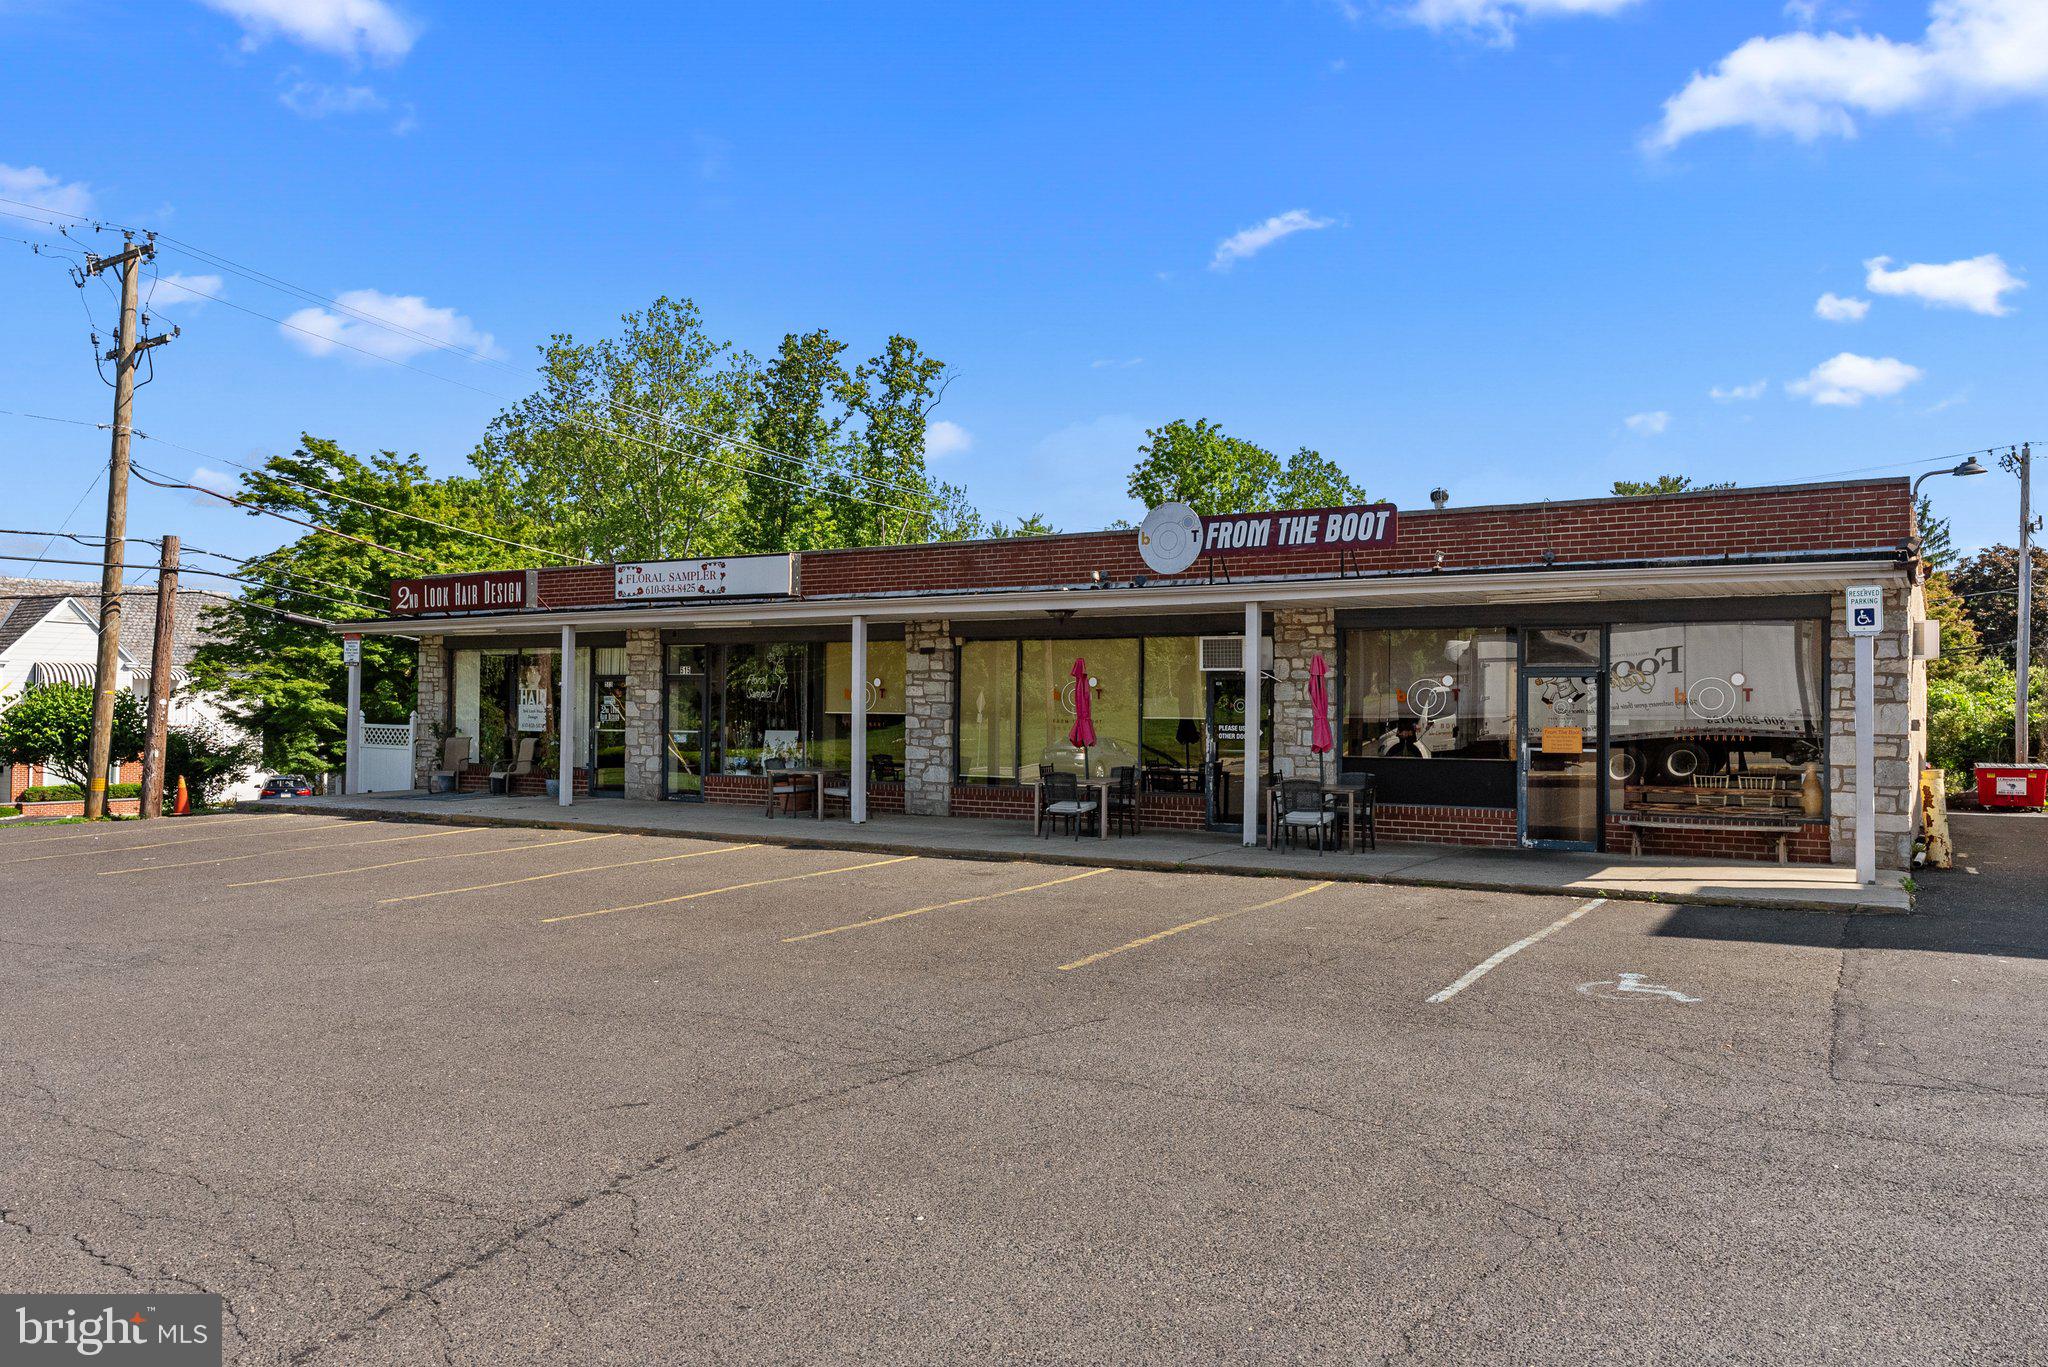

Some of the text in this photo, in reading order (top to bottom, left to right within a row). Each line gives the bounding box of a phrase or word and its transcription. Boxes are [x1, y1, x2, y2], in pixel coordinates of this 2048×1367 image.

[1205, 510, 1391, 549] FROM THE BOOT
[625, 570, 718, 584] FLORAL SAMPLER
[395, 580, 523, 610] 2ND LOOK HAIR DESIGN
[645, 583, 696, 595] 610-834-8425
[1848, 589, 1880, 597] RESERVED
[1850, 597, 1879, 605] PARKING
[1218, 724, 1238, 732] PLEASE
